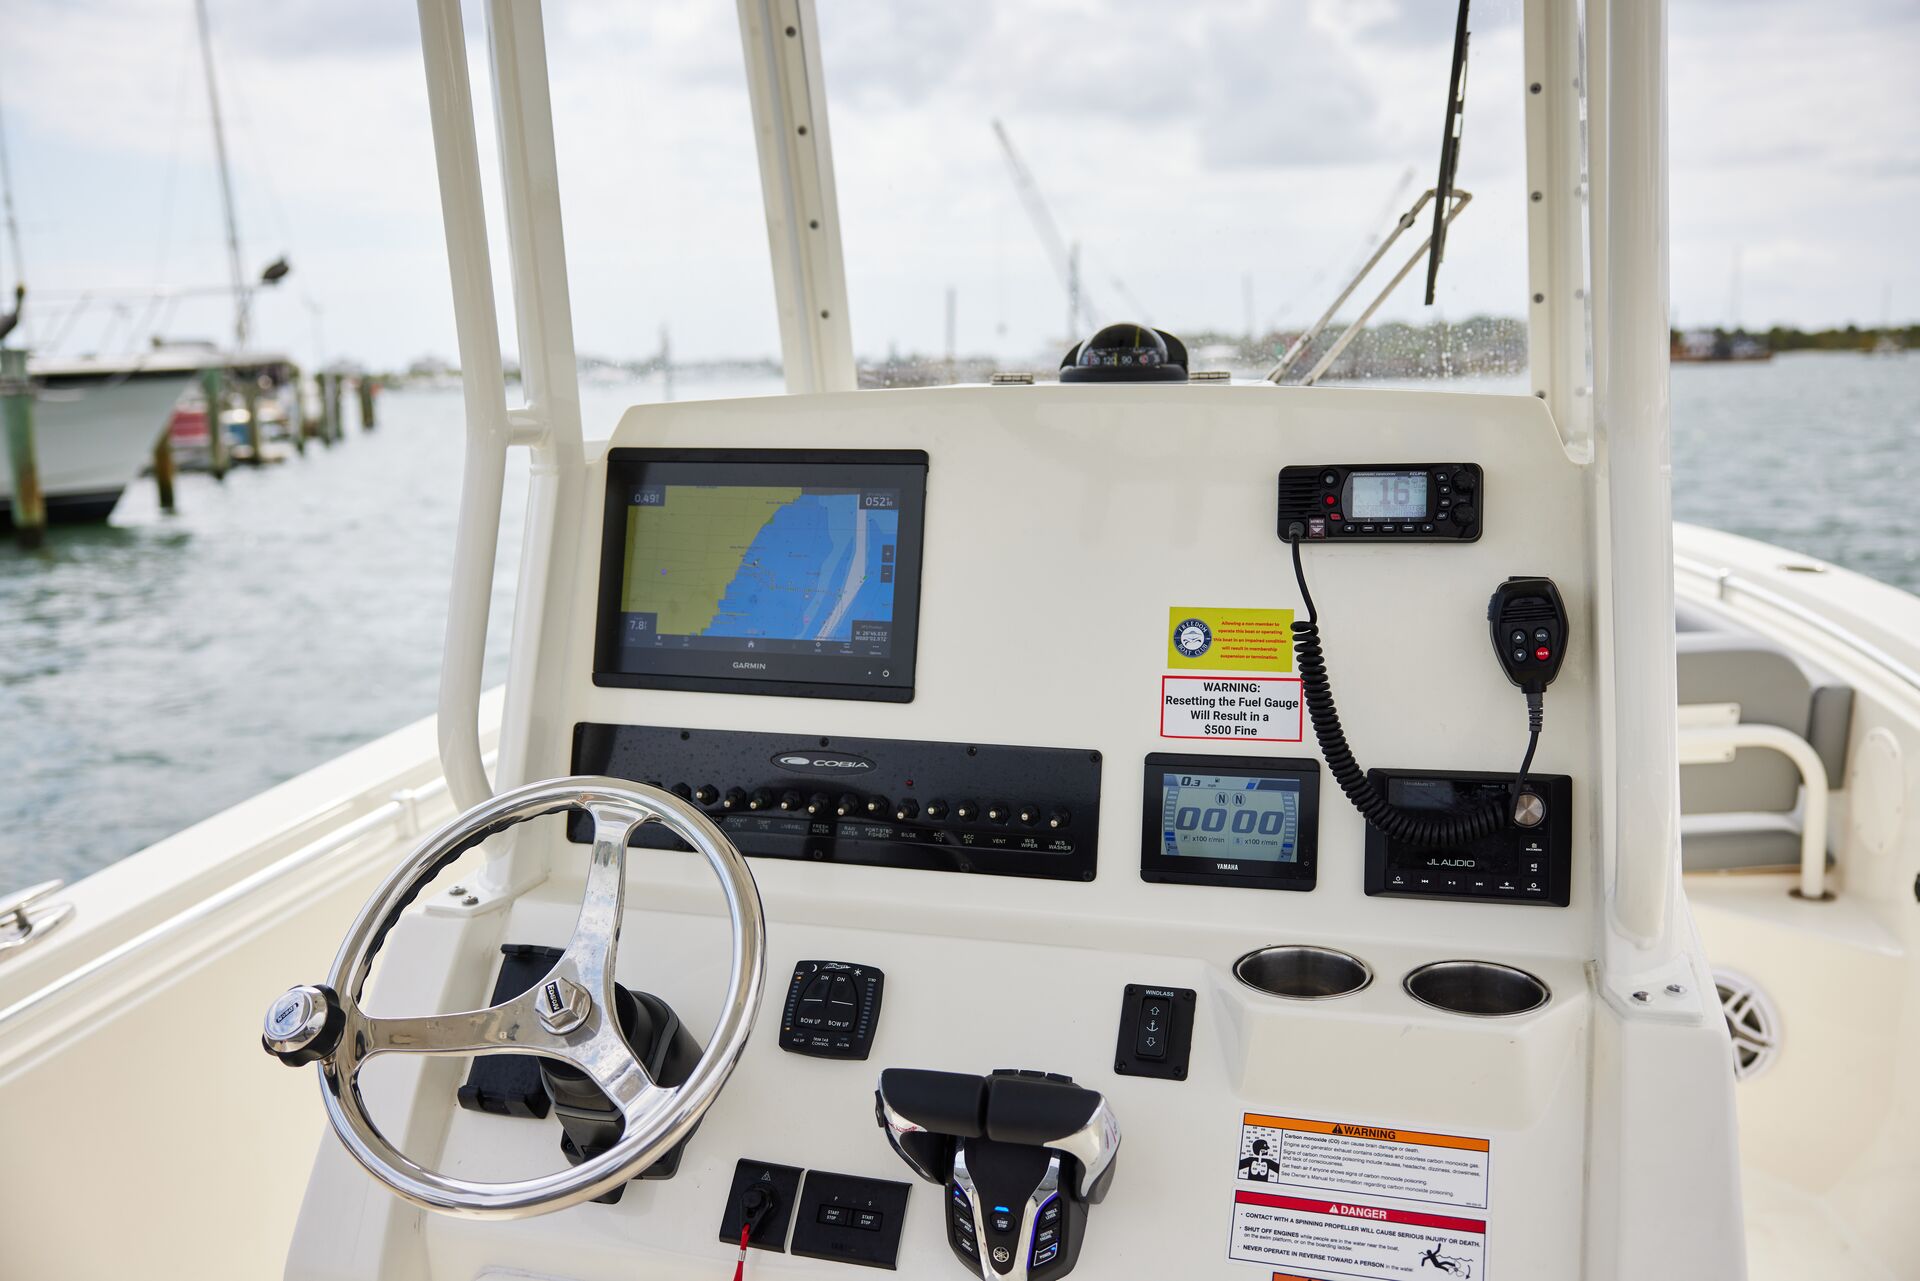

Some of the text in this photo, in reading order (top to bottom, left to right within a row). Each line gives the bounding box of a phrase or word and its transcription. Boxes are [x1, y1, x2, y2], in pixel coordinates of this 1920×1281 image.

[1380, 480, 1409, 504] 16
[1179, 621, 1207, 632] FREEDOM
[1178, 644, 1208, 656] BOAT CLUB
[732, 662, 766, 670] GARMIN
[1204, 682, 1260, 693] WARNING:
[1165, 696, 1299, 710] Resetting the Fuel Gauge
[1191, 710, 1210, 720] Will
[1213, 711, 1247, 721] Result
[1250, 712, 1259, 721] in
[1204, 724, 1257, 735] $500 Fine
[813, 759, 869, 768] COBIA
[1181, 776, 1200, 787] 0.3
[1218, 794, 1243, 804] N N
[1175, 806, 1228, 832] 00
[1231, 810, 1284, 835] 00
[1441, 859, 1475, 868] AUDIO
[547, 984, 560, 1010] EDSON
[1344, 1126, 1396, 1140] WARNING
[1341, 1206, 1386, 1219] DANGER
[1246, 1212, 1272, 1221] CONTACT
[1295, 1219, 1323, 1227] SPINNING
[1324, 1222, 1359, 1231] PROPELLER
[1398, 1232, 1424, 1240] SERIOUS
[1274, 1229, 1299, 1237] ENGINES
[1264, 1247, 1290, 1256] OPERATE
[1299, 1252, 1326, 1260] REVERSE
[1327, 1256, 1353, 1264] TOWARD
[1360, 1260, 1384, 1268] PERSON
